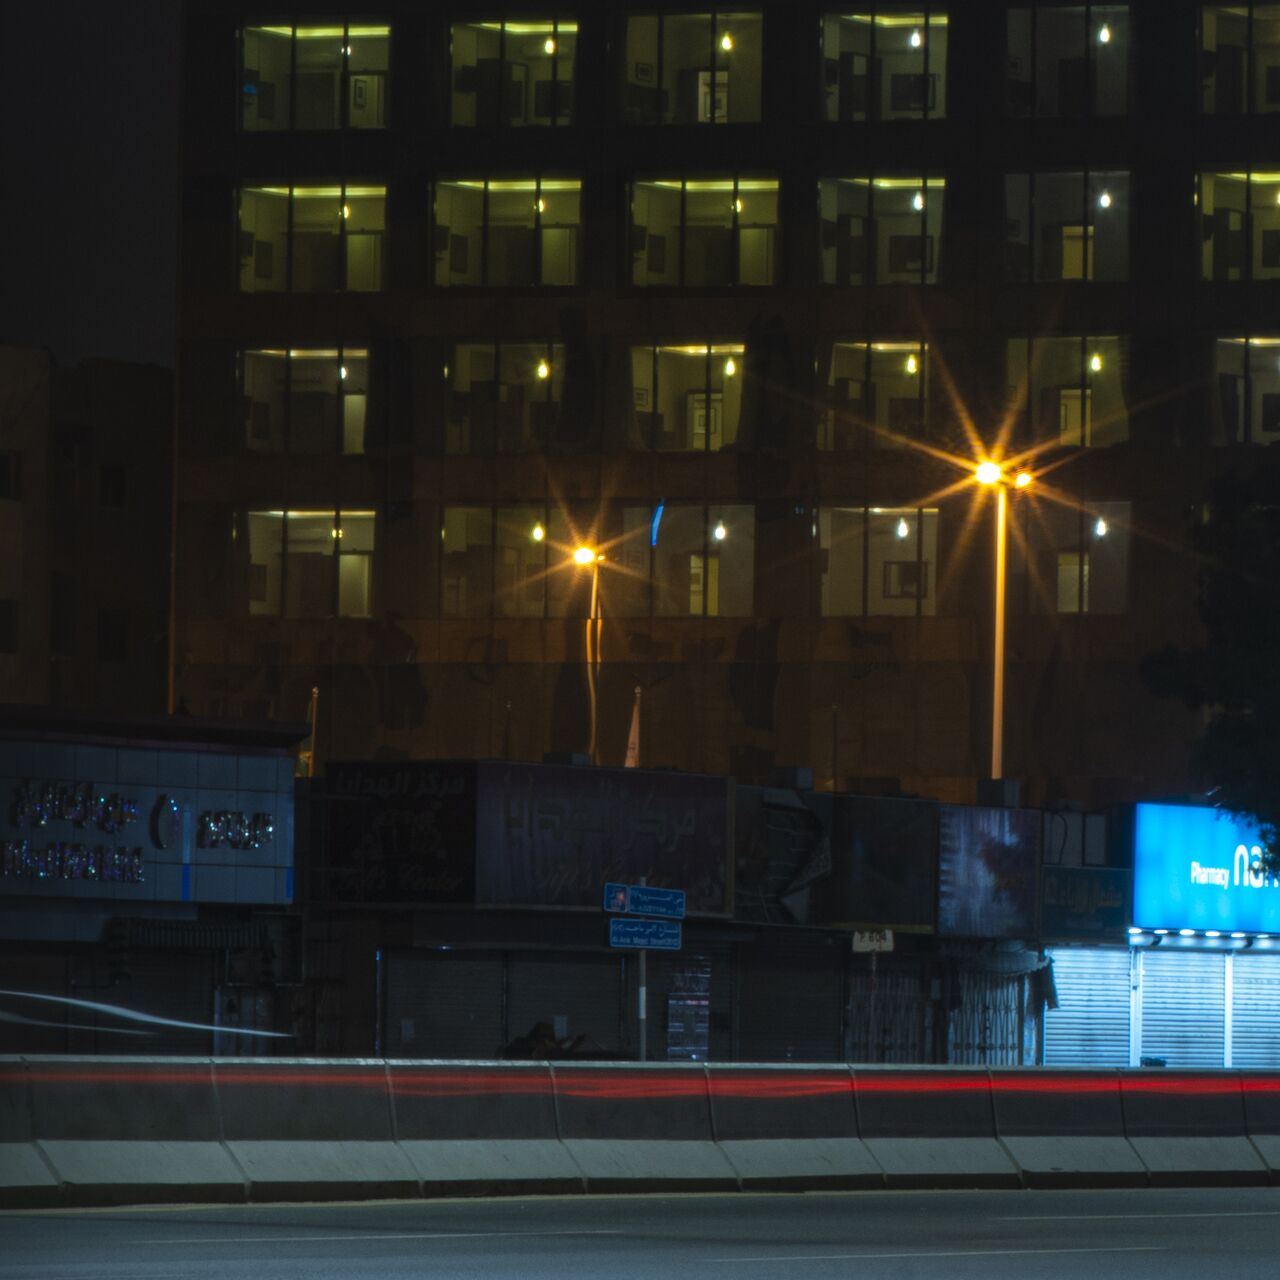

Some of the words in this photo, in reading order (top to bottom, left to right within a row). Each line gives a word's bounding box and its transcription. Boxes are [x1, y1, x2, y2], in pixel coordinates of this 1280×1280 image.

[335, 771, 411, 799] الهدايا
[413, 771, 465, 798] مركز
[1191, 861, 1230, 890] Pharmacy
